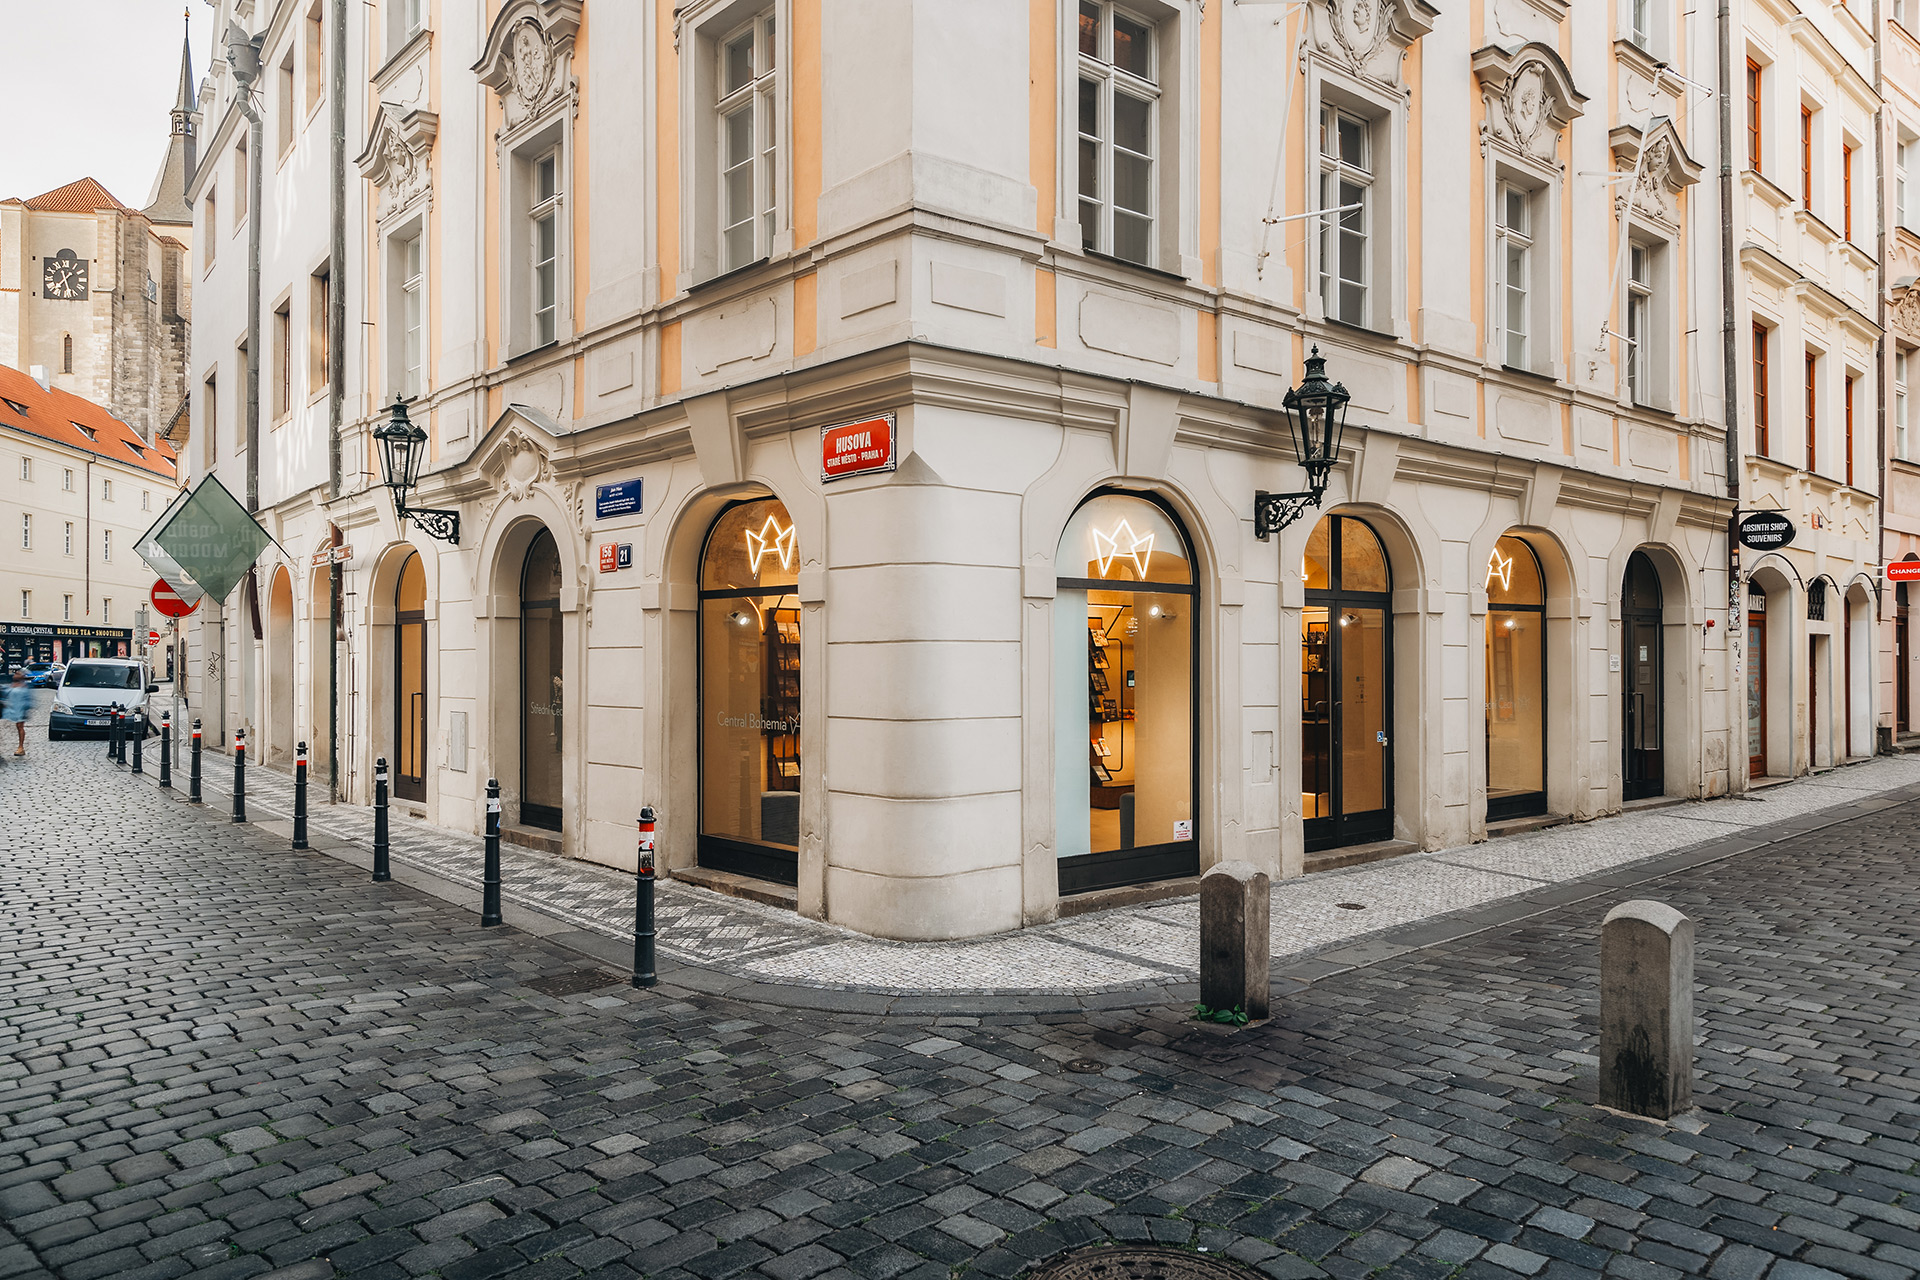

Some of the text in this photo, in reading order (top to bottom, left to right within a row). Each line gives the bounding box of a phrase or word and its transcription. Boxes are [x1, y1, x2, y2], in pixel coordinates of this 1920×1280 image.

[836, 431, 871, 453] HUSOVA
[827, 455, 841, 467] STARÉ
[841, 453, 857, 465] MĚSTO
[861, 449, 879, 461] PRAHA
[879, 448, 884, 458] 1
[1742, 522, 1788, 532] ABSINTH SHOP
[1747, 533, 1782, 543] SOUVENIRS
[620, 549, 628, 562] 21
[57, 628, 79, 636] BUBBLE
[80, 629, 91, 637] TEA
[717, 711, 787, 731] Central Bohemia
